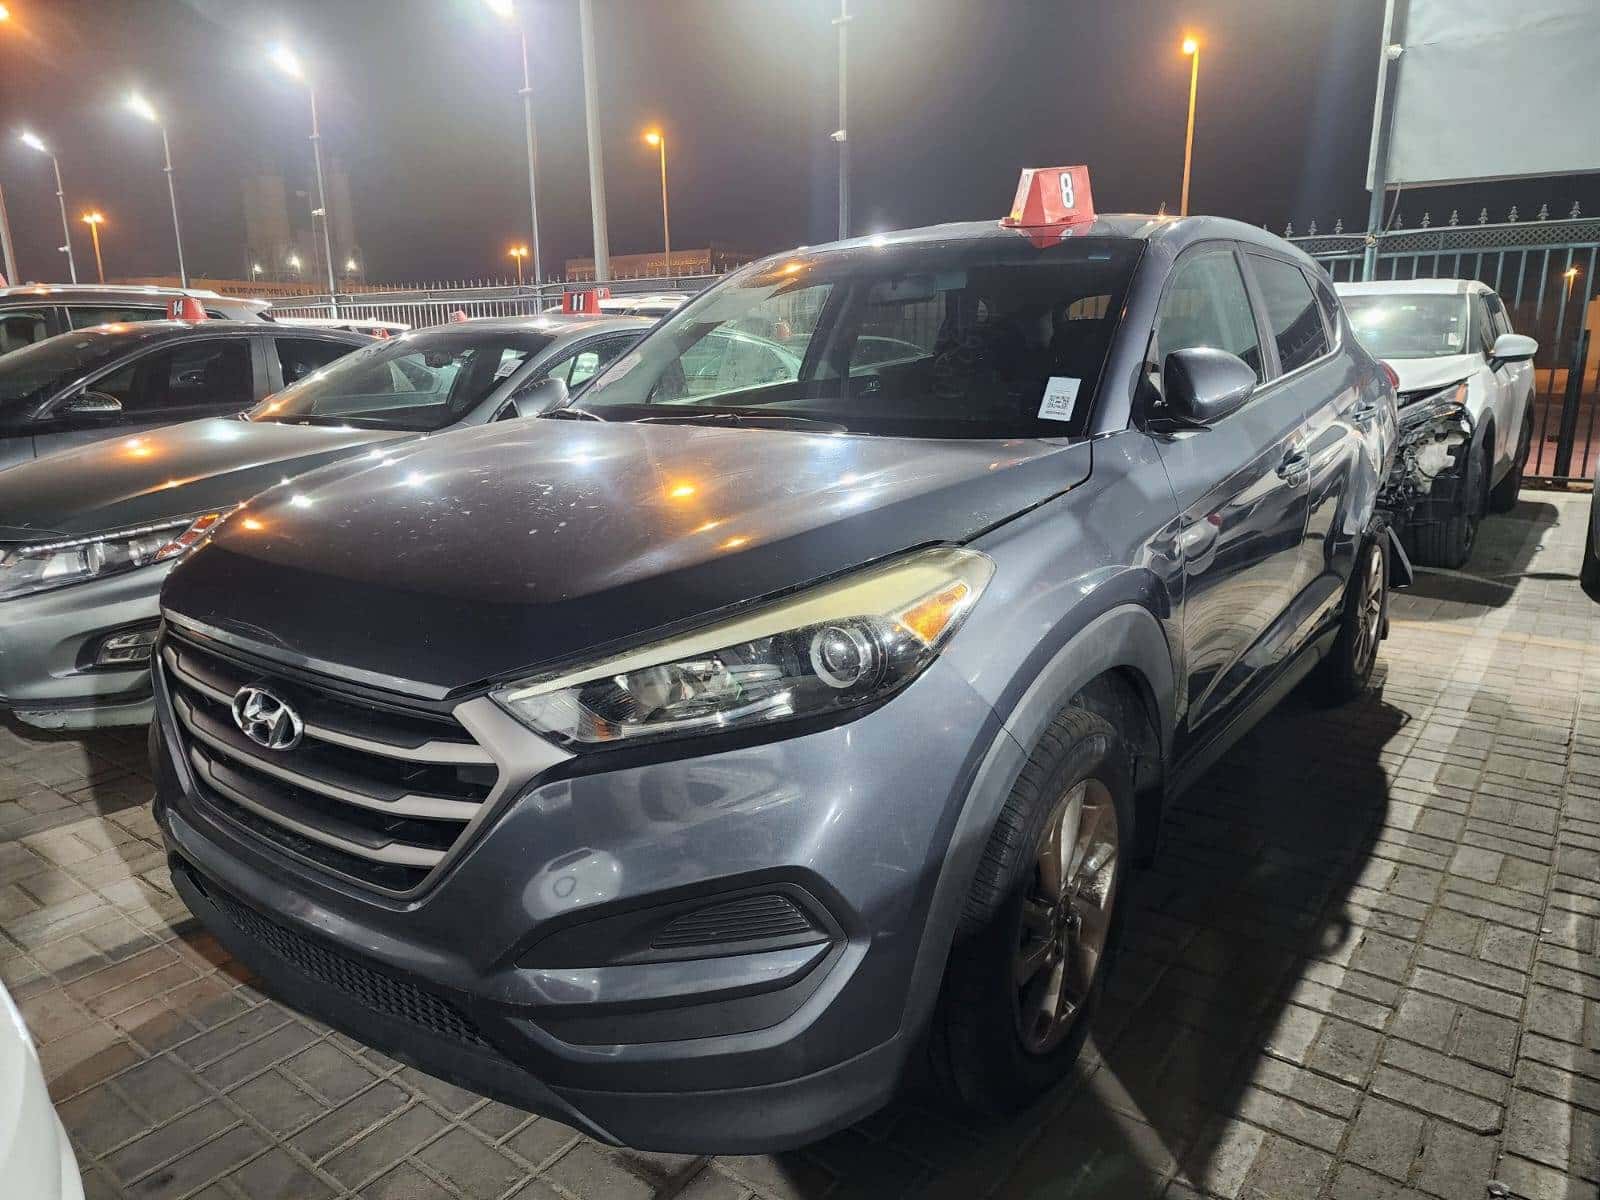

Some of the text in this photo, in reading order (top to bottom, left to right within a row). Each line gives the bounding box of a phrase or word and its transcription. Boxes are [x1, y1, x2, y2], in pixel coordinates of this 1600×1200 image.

[1059, 172, 1075, 208] 8
[173, 300, 183, 316] 14
[572, 293, 584, 311] 11
